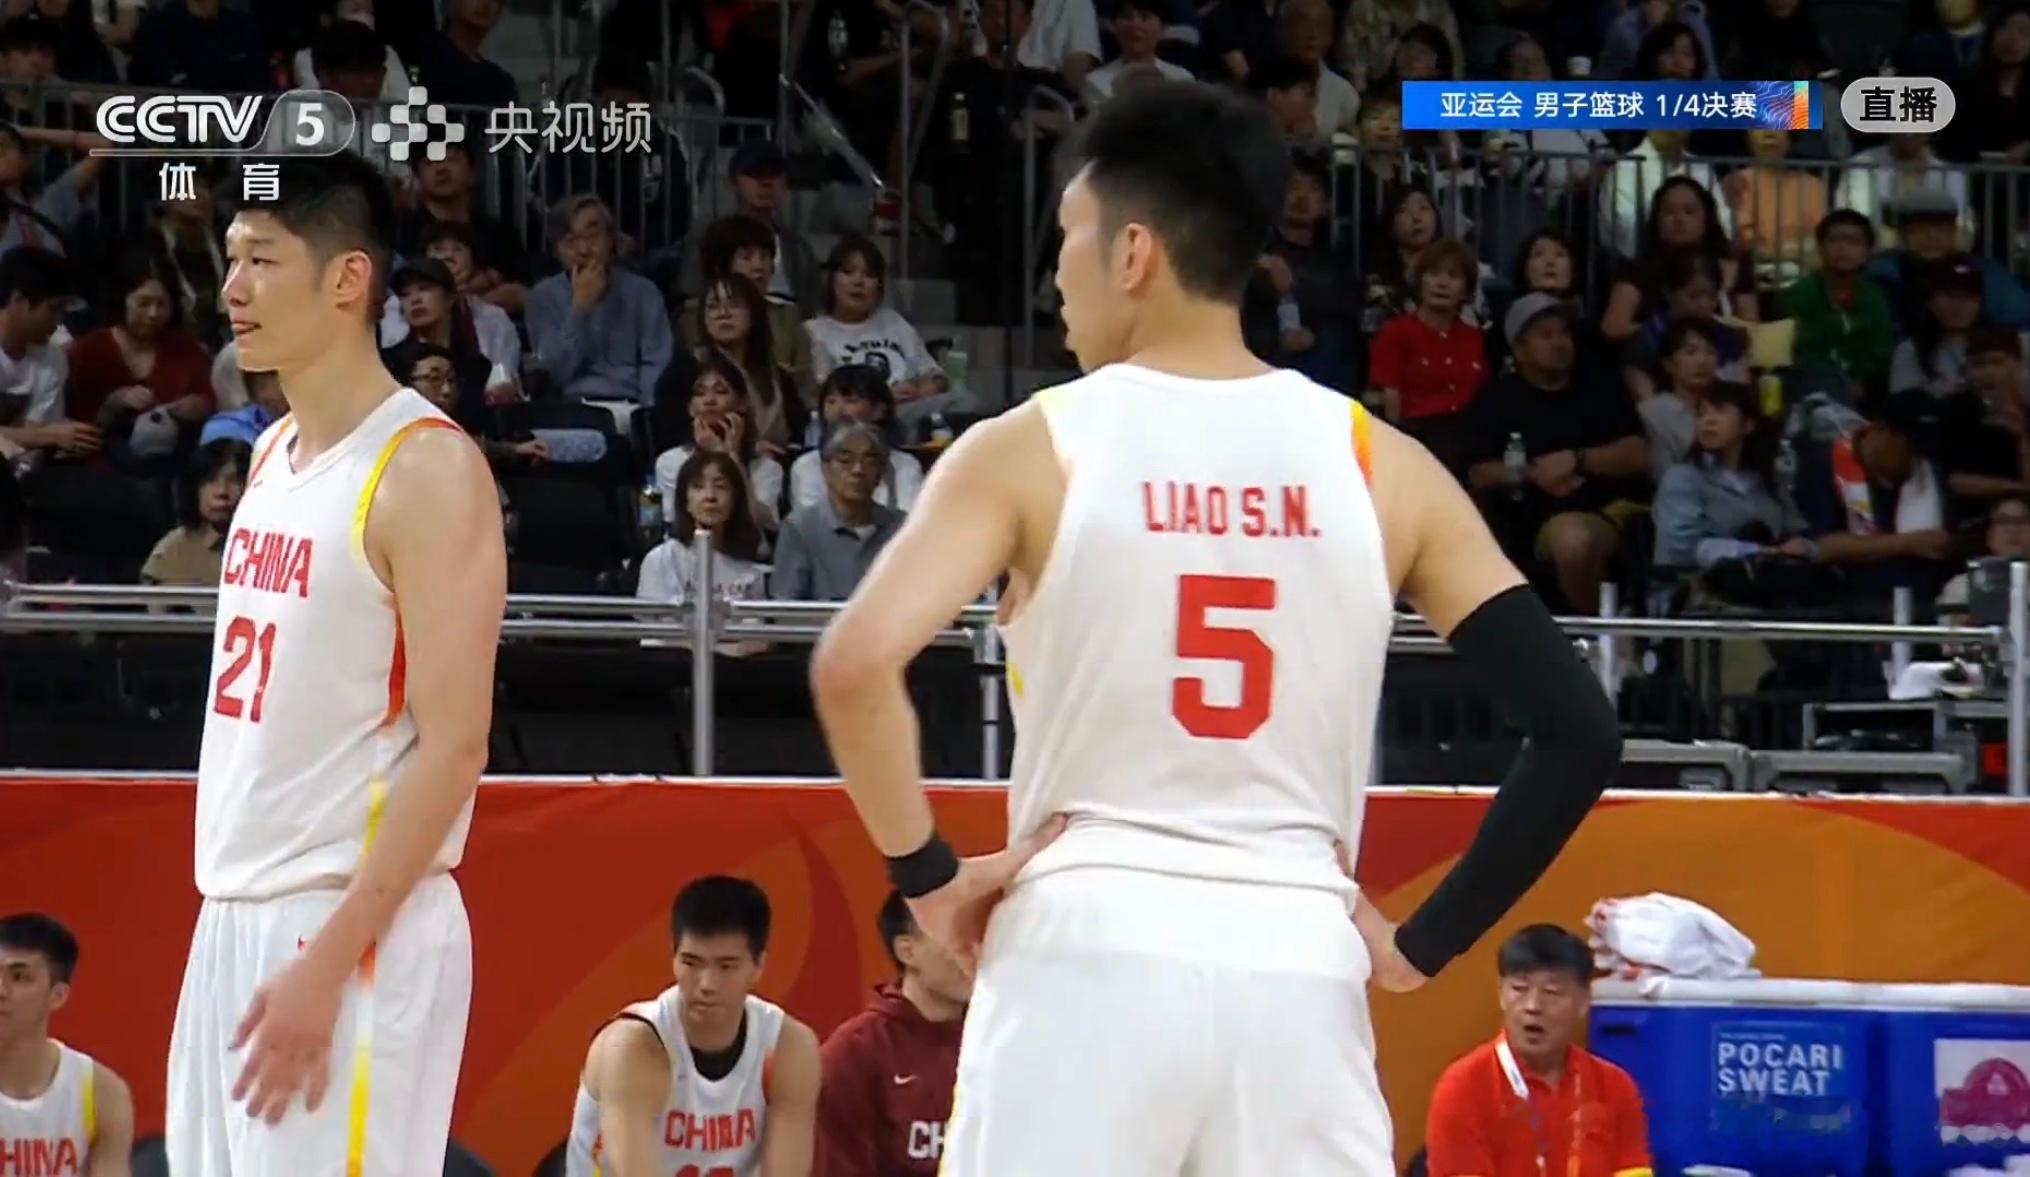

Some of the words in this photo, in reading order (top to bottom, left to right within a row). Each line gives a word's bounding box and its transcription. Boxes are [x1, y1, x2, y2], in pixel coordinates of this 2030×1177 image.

[1142, 481, 1228, 536] LIAO
[1241, 485, 1321, 537] S.N.
[223, 528, 313, 598] CHINA
[214, 616, 277, 723] 21
[1171, 574, 1276, 740] 5
[1717, 1042, 1844, 1069] POCARI
[1717, 1067, 1831, 1096] SWEAT
[0, 1137, 78, 1177] HINA
